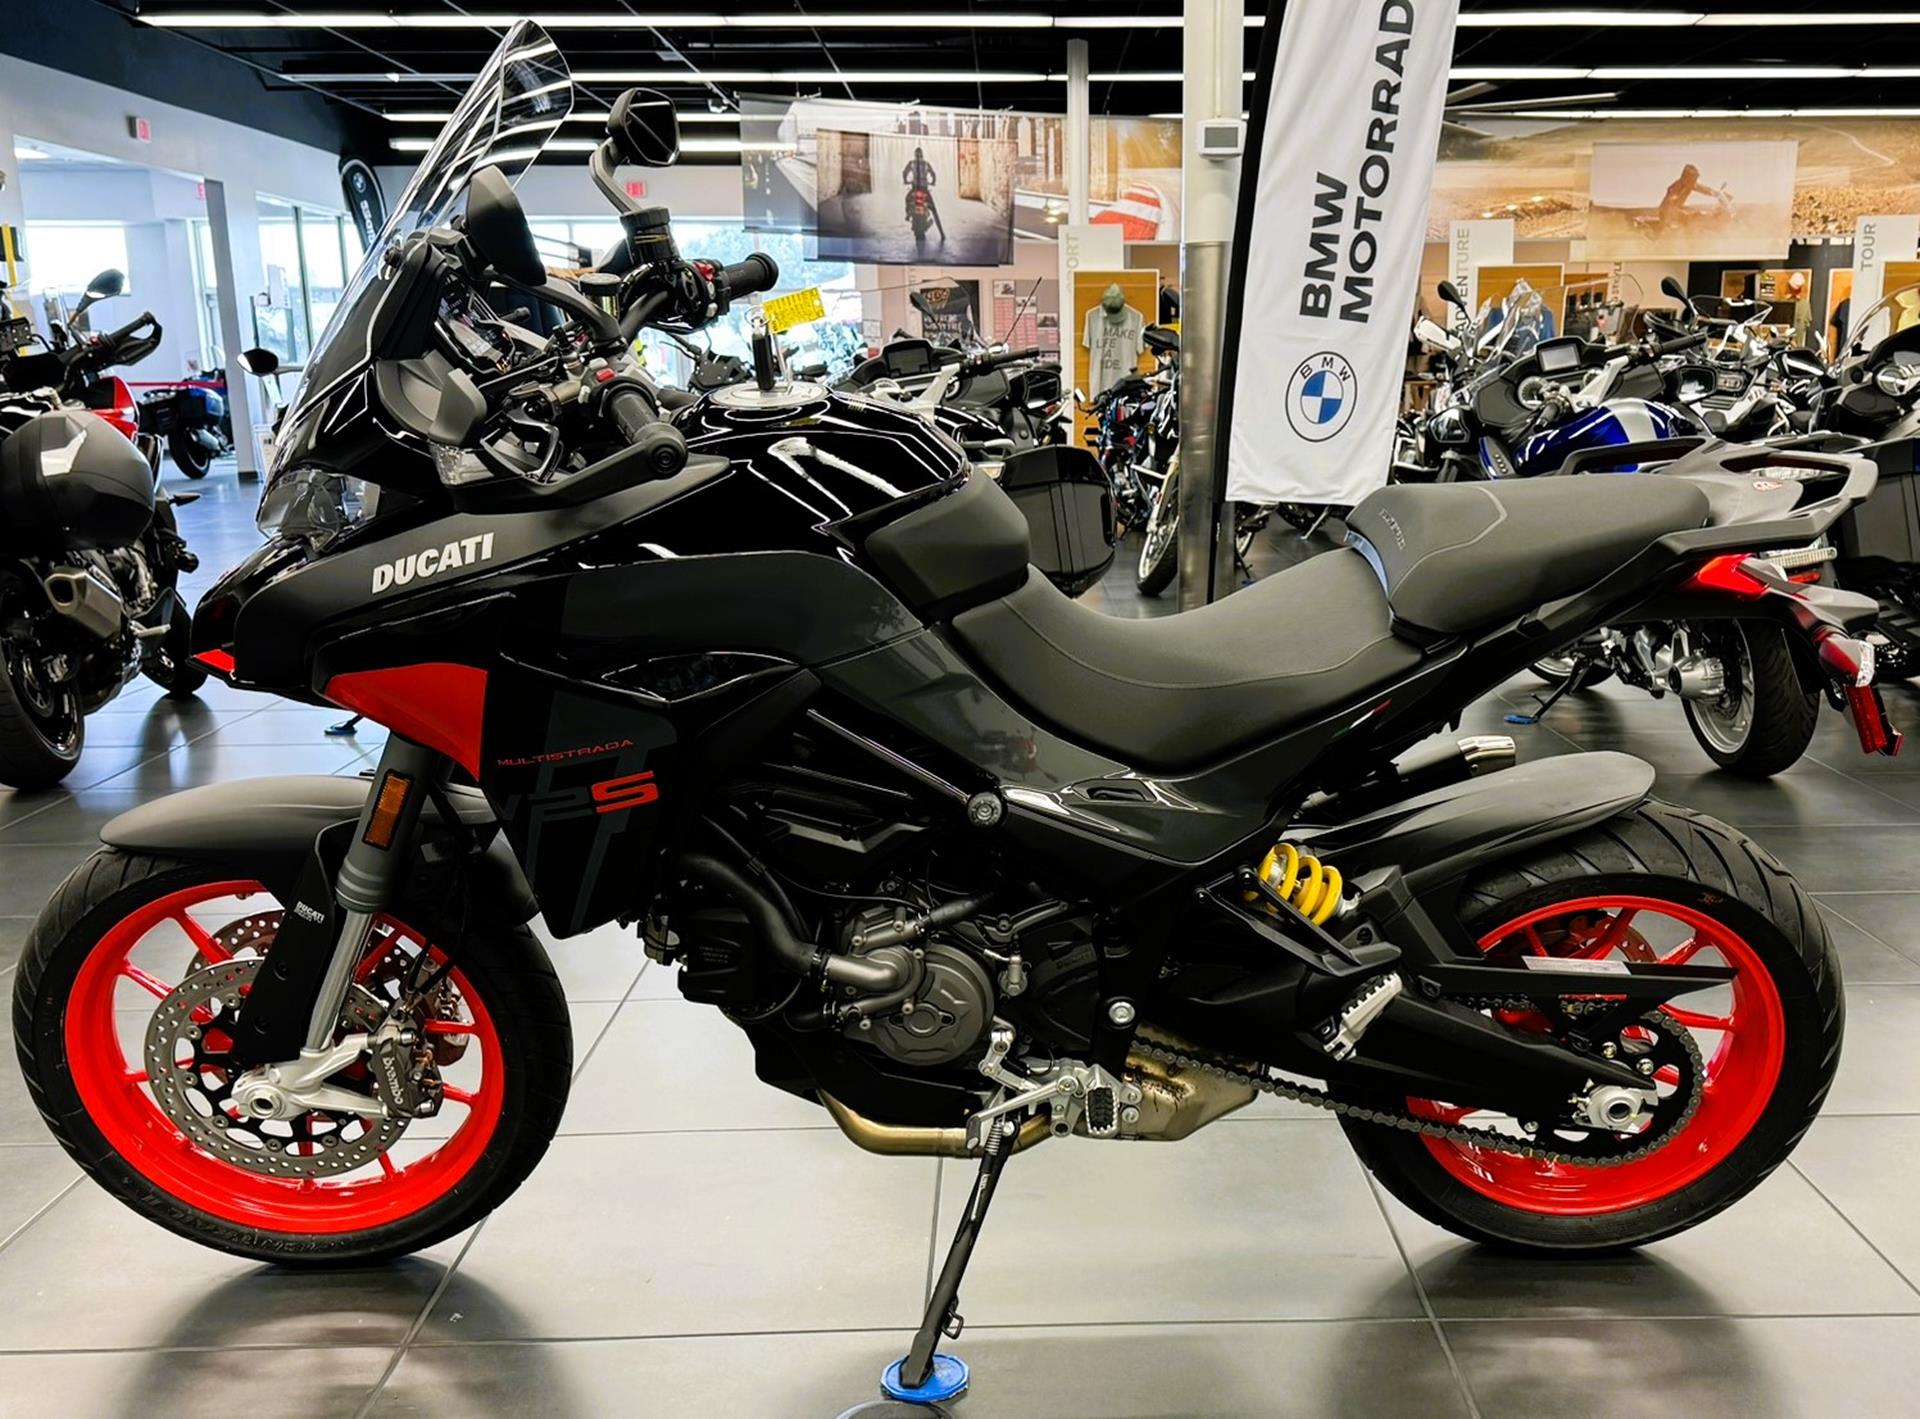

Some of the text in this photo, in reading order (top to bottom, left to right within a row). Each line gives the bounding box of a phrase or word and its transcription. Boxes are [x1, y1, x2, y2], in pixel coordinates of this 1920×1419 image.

[1339, 0, 1414, 323] MOTORRAD
[1299, 171, 1348, 318] BMW
[1860, 223, 1876, 271] TOUR
[1103, 327, 1135, 340] MAKE
[1300, 356, 1351, 382] BMW
[372, 532, 494, 594] DUCATI
[497, 739, 634, 766] MULTISTRADA
[297, 901, 325, 923] DUCATI
[382, 1057, 404, 1105] brembo
